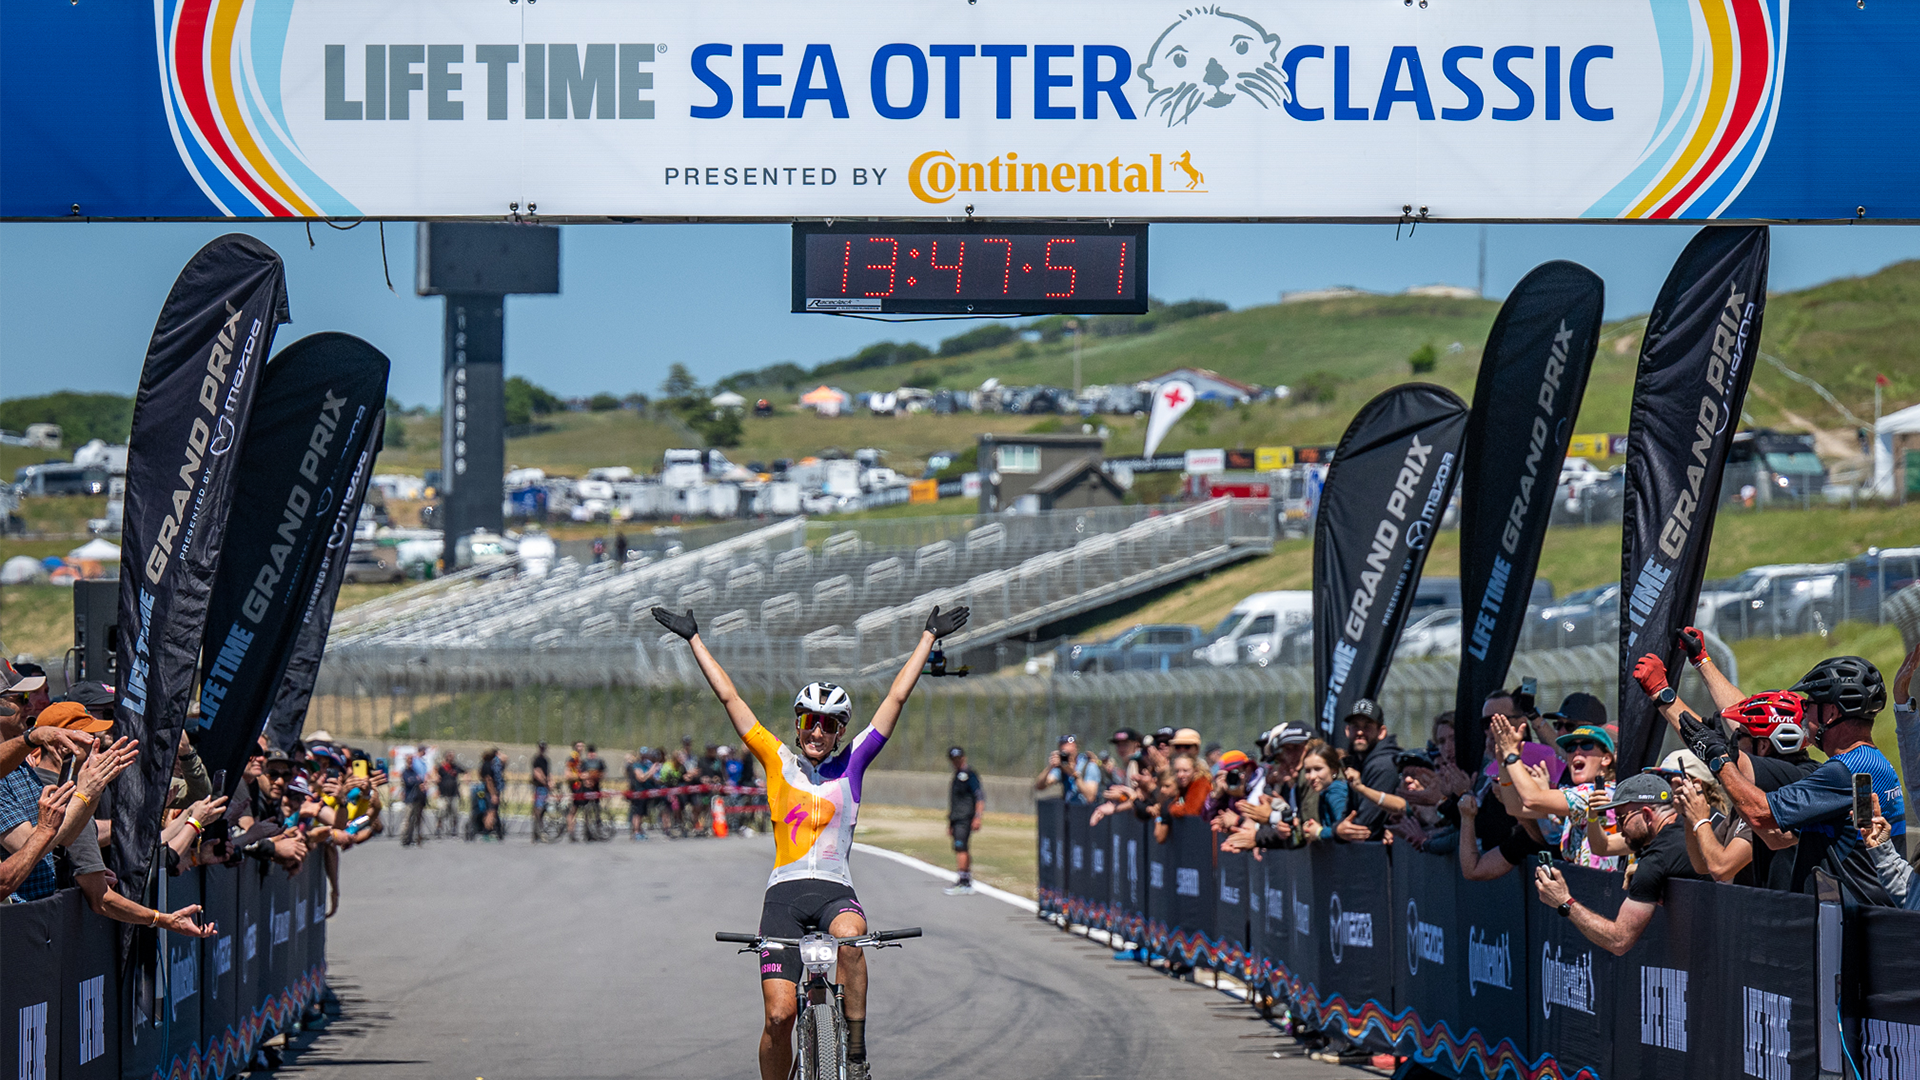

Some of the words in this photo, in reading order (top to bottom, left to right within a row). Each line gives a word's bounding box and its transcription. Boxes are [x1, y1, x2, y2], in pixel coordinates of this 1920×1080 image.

[324, 44, 464, 120] LIFE
[475, 43, 656, 120] TIME
[689, 43, 850, 120] SEA
[869, 43, 1138, 121] OTTER
[1282, 44, 1615, 122] CLASSIC
[664, 167, 838, 186] PRESENTED
[853, 167, 888, 186] BY
[907, 149, 1166, 205] Continental
[1538, 318, 1574, 416] PRIX
[145, 417, 211, 585] GRAND
[199, 300, 243, 416] PRIX
[299, 388, 348, 485] PRIX
[1658, 395, 1719, 560] GRAND
[1706, 280, 1745, 397] PRIX
[179, 488, 206, 561] PRESENTED
[202, 467, 212, 485] BY
[1501, 416, 1549, 555] GRAND
[242, 484, 312, 624] GRAND
[1344, 519, 1400, 643] GRAND
[1386, 434, 1433, 521] PRIX
[1481, 553, 1512, 615] TIME
[210, 622, 255, 683] TIME
[1468, 609, 1497, 663] LIFE
[200, 677, 228, 731] LIFE
[805, 946, 833, 962] 19
